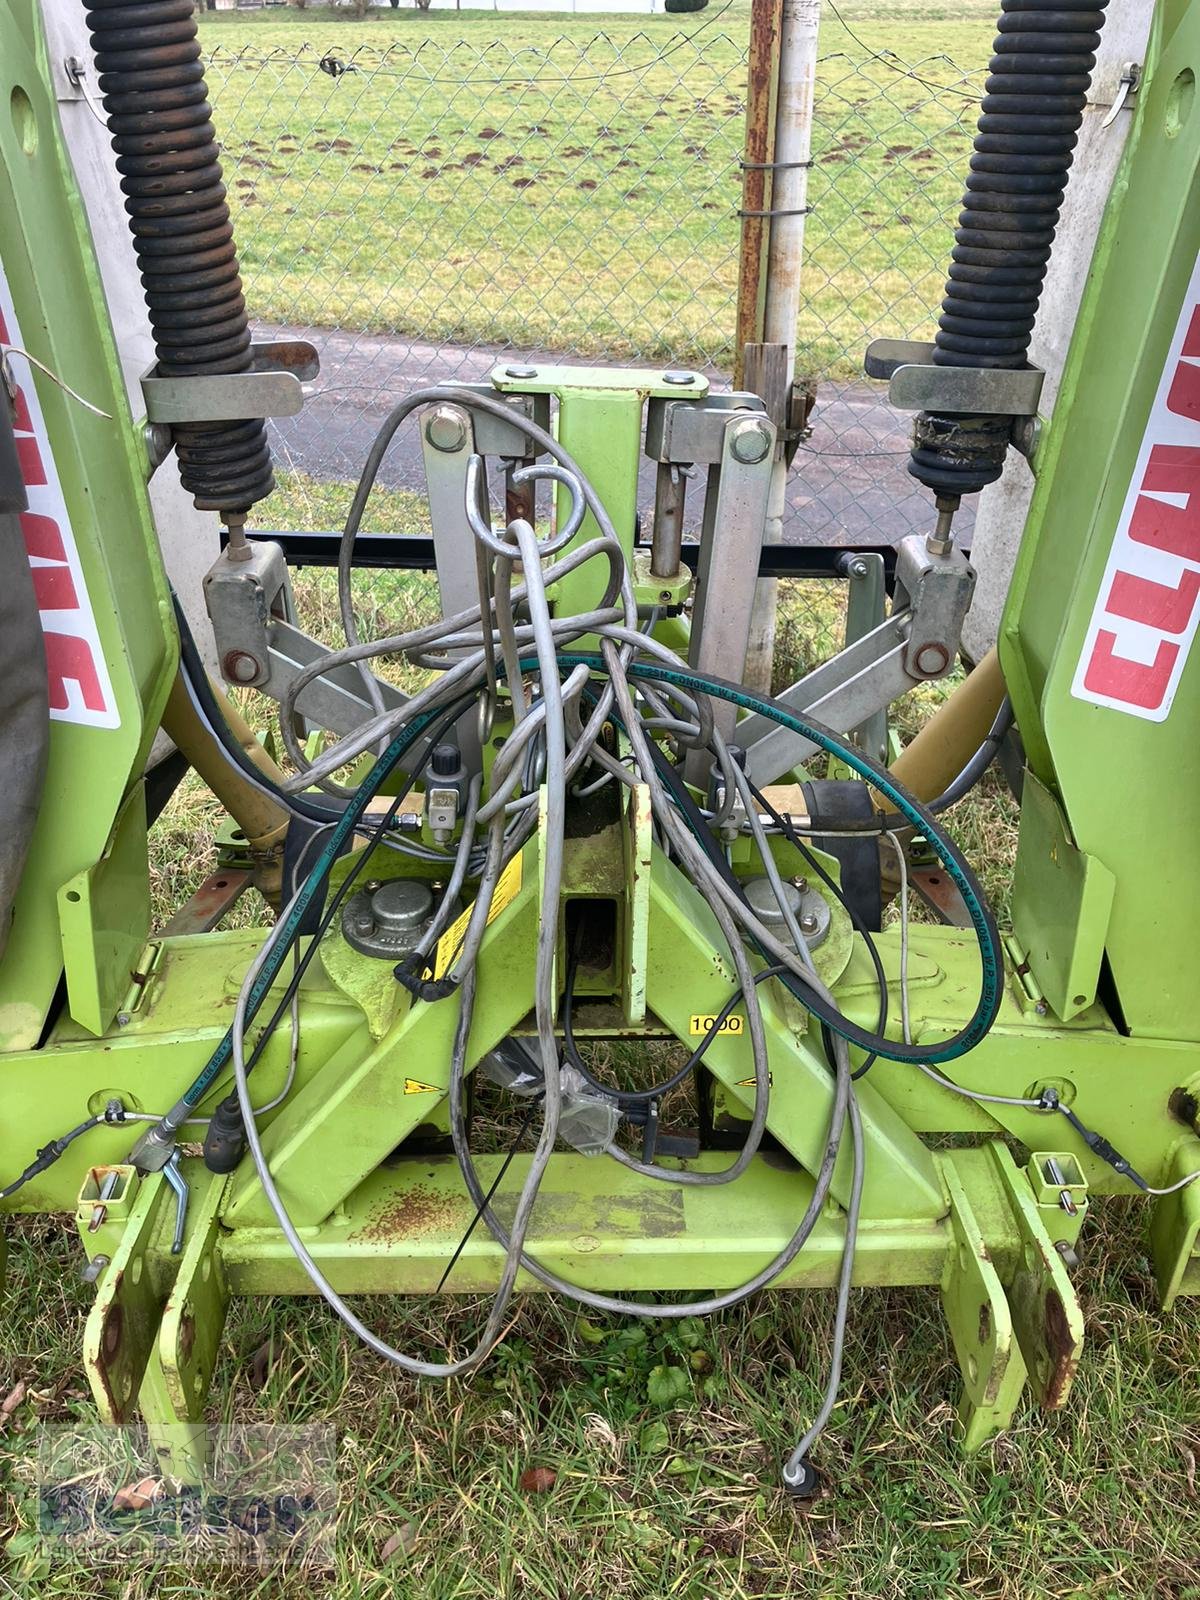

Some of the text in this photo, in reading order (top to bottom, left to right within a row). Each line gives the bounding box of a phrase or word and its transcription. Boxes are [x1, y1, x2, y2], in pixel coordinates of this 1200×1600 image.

[268, 944, 282, 963] 350
[983, 983, 994, 1002] 350
[692, 1017, 741, 1031] 1000
